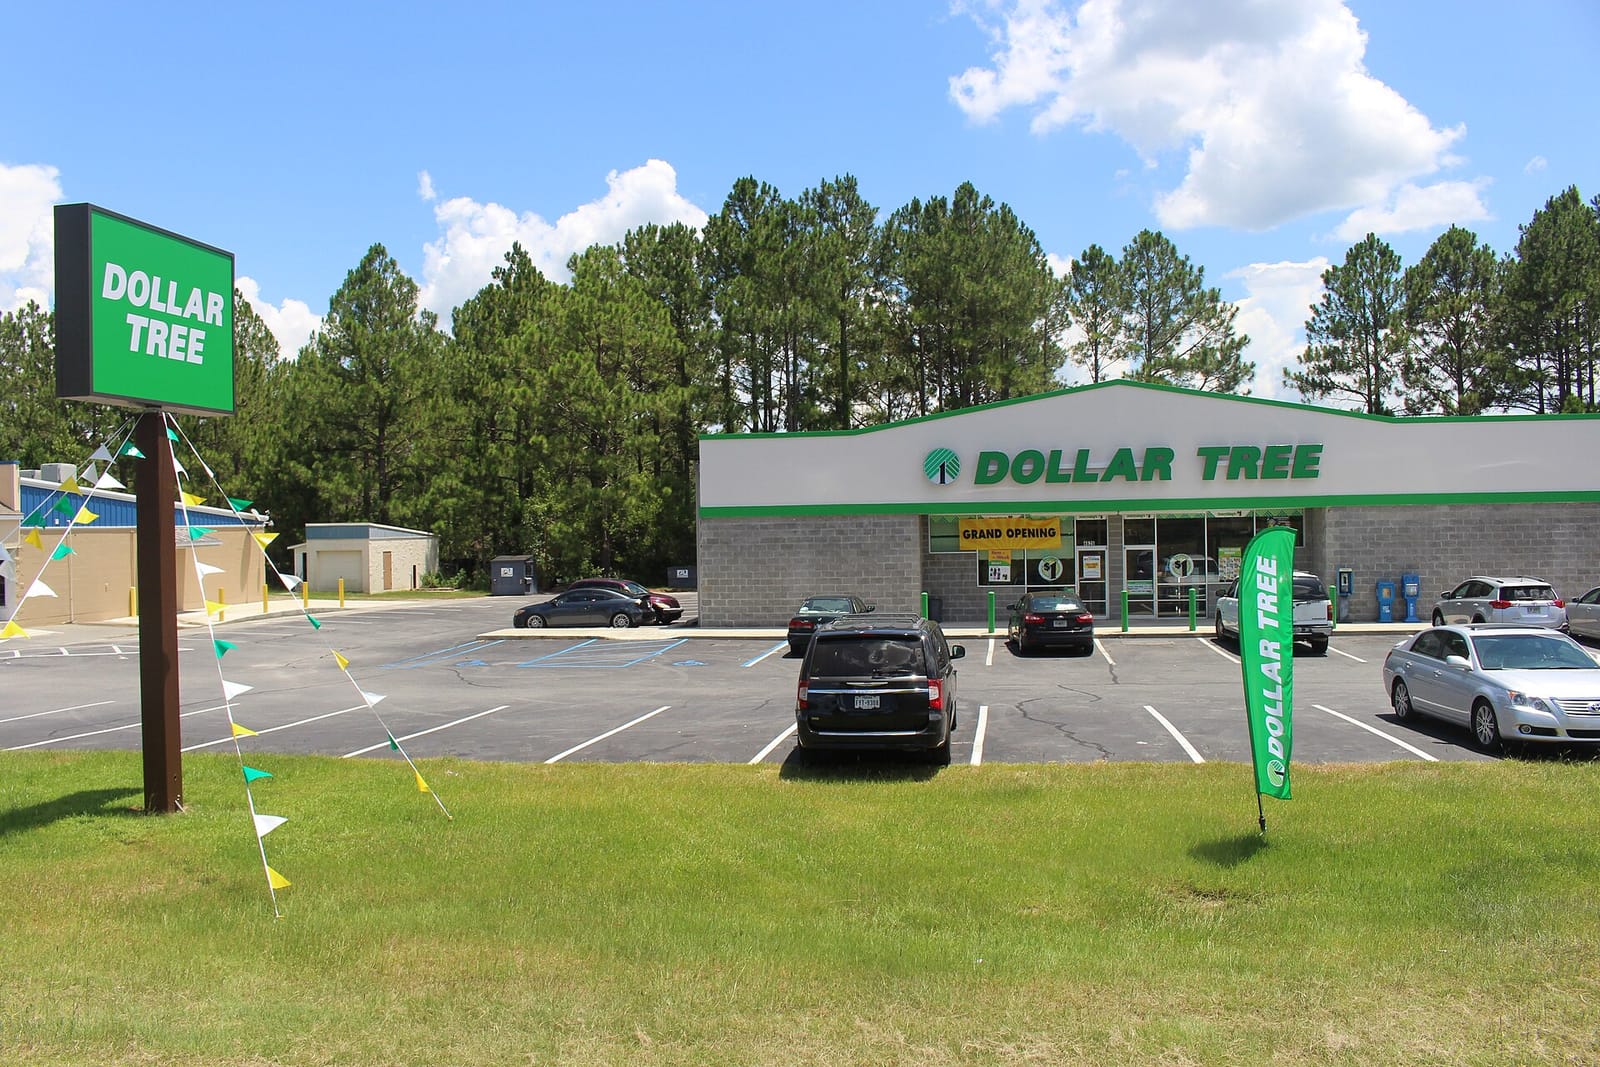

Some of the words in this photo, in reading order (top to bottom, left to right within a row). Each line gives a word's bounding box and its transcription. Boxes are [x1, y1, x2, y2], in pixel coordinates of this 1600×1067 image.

[102, 262, 225, 327] DOLLAR
[126, 313, 206, 365] TREE
[974, 447, 1175, 485] DOLLAR
[1196, 444, 1324, 480] TREE
[962, 528, 1003, 540] GRAND
[1006, 527, 1057, 538] OPENING
[1043, 561, 1057, 579] $1
[1174, 559, 1188, 577] $1
[1256, 555, 1279, 630] TREE
[1260, 640, 1285, 760] DOLLAR
